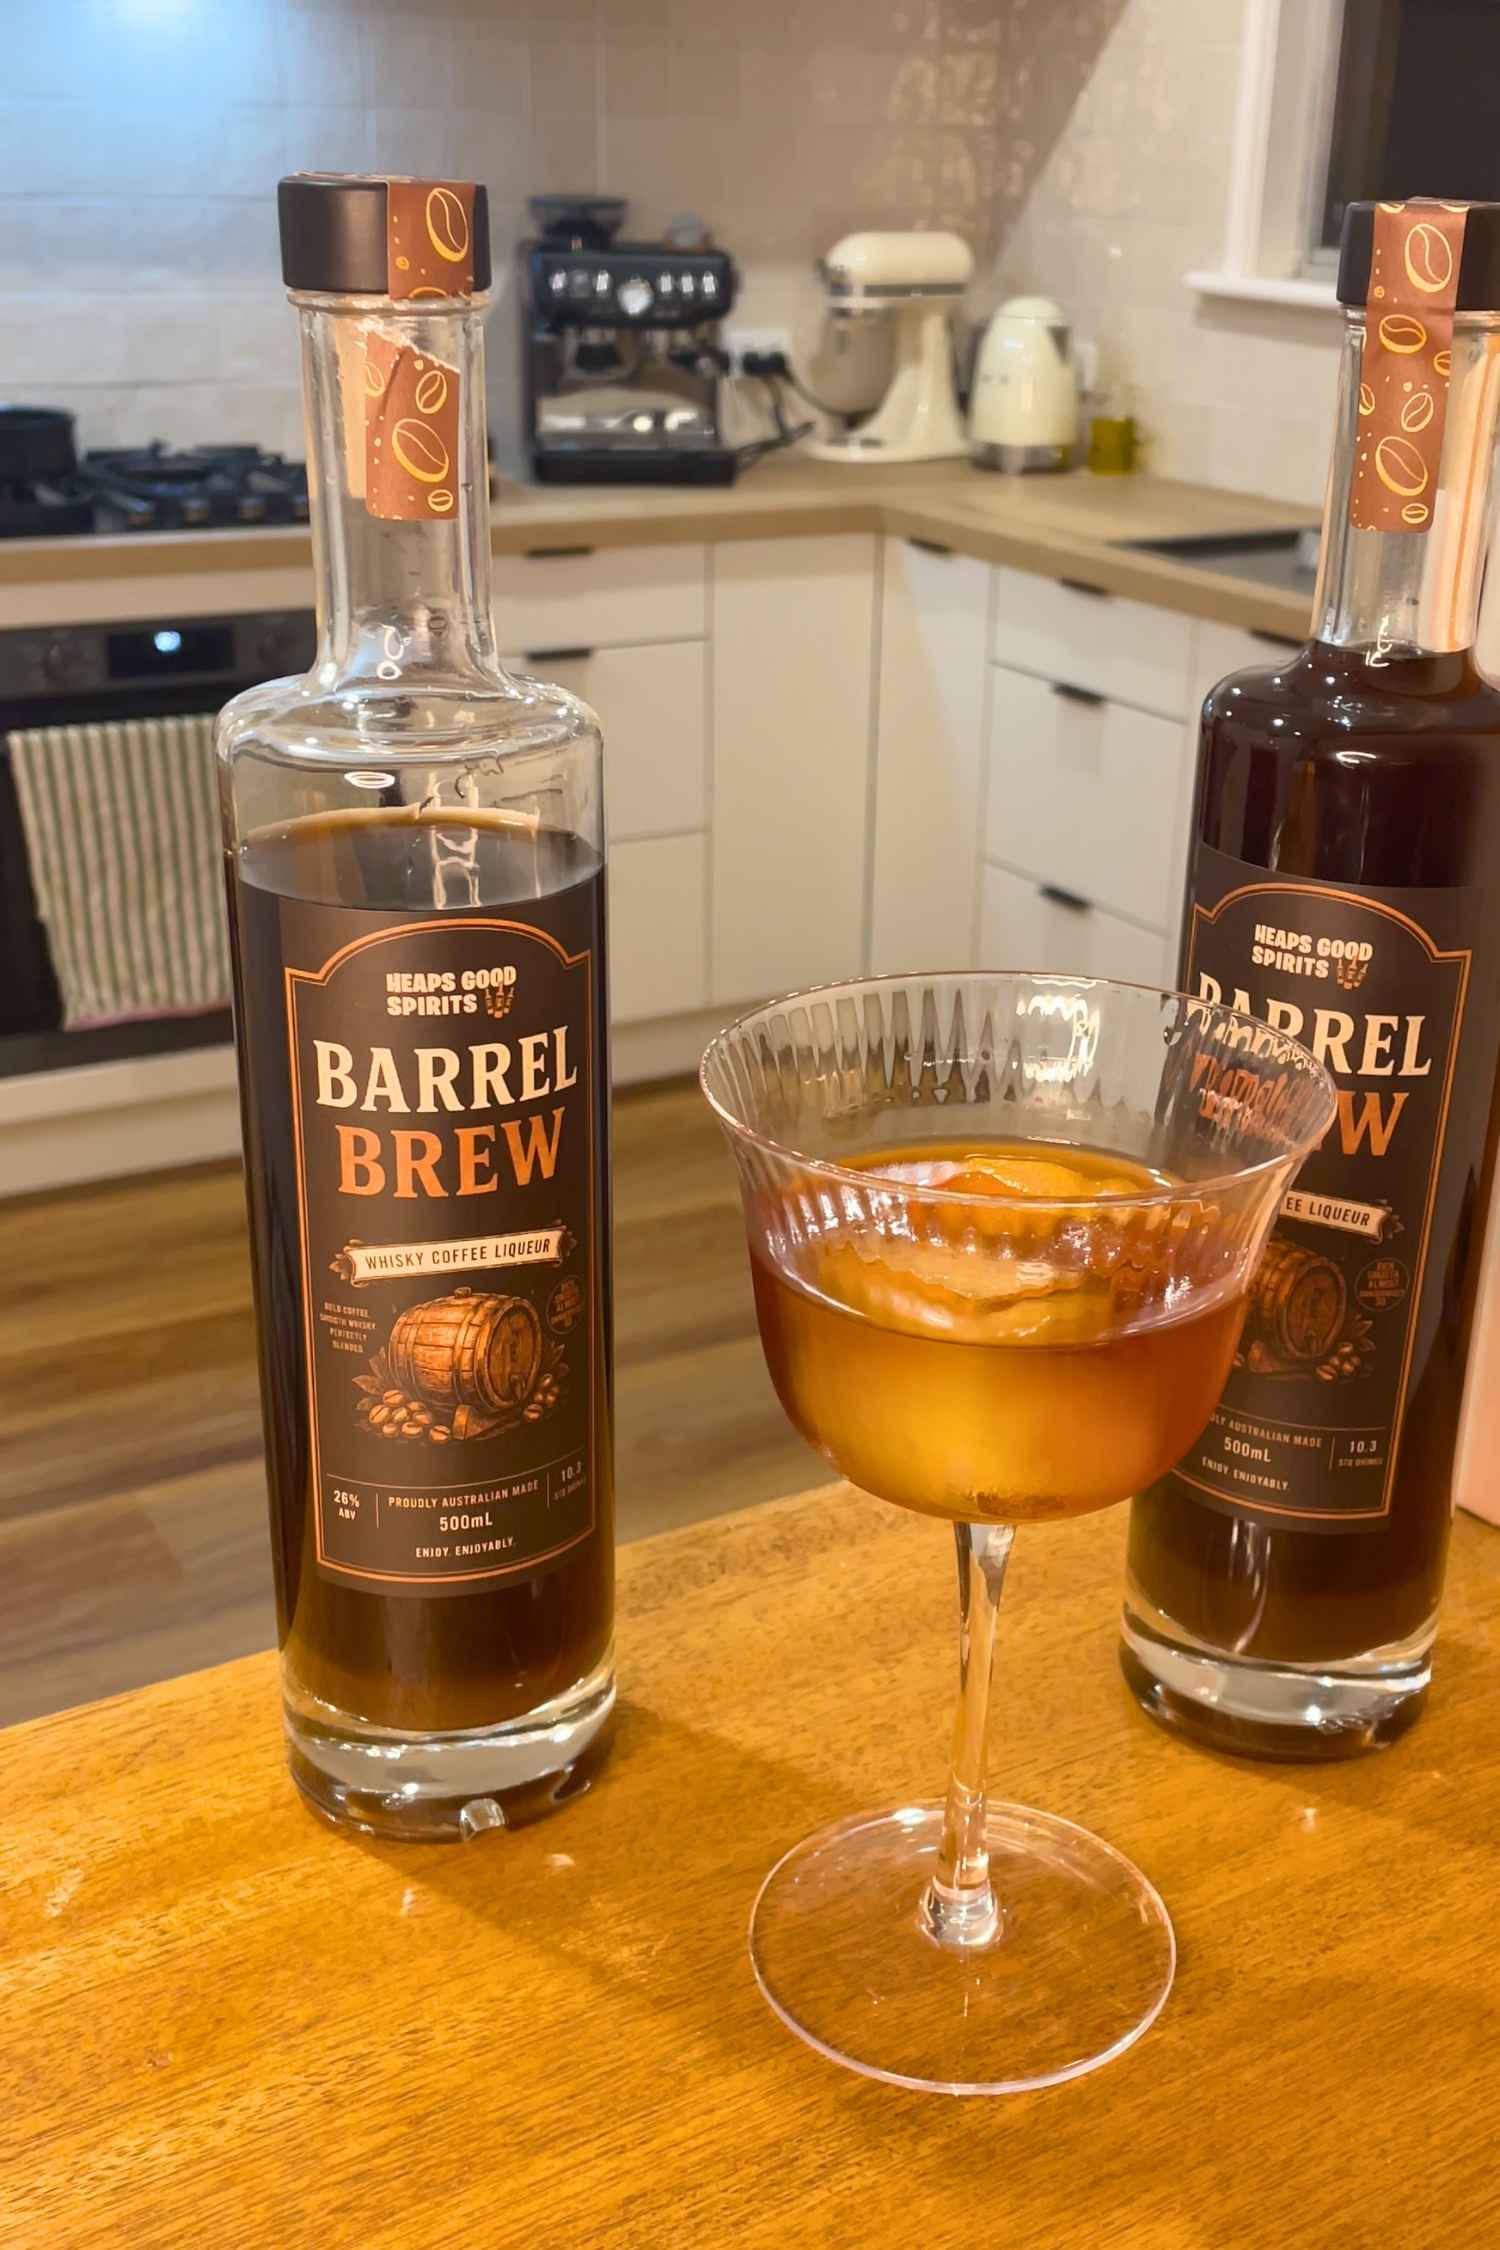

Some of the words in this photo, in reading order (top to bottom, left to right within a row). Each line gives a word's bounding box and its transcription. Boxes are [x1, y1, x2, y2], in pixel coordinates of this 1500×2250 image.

[1254, 924, 1312, 953] HEAPS
[1316, 938, 1374, 962] GOOD
[1252, 946, 1330, 978] SPIRITS
[386, 971, 456, 993] HEAPS
[461, 966, 518, 990] GOOD
[386, 994, 478, 1016] SPIRITS
[313, 1025, 578, 1113] BARREL
[335, 1106, 566, 1199] BREW
[1308, 1200, 1371, 1227] LIQUEUR
[365, 1252, 424, 1271] WHISKY
[431, 1246, 488, 1265] COFFEE
[495, 1238, 551, 1258] LIQUEUR
[1228, 1418, 1290, 1444] AUSTRALIAN
[1293, 1435, 1323, 1448] MADE
[1350, 1440, 1378, 1453] 10.3
[1223, 1437, 1273, 1463] 500mL
[333, 1490, 360, 1508] 26%
[388, 1496, 438, 1509] PROUDLY
[441, 1488, 508, 1508] AUSTRALIAN
[512, 1479, 539, 1497] MADE
[338, 1508, 356, 1521] ABV
[439, 1511, 494, 1532] 500mL
